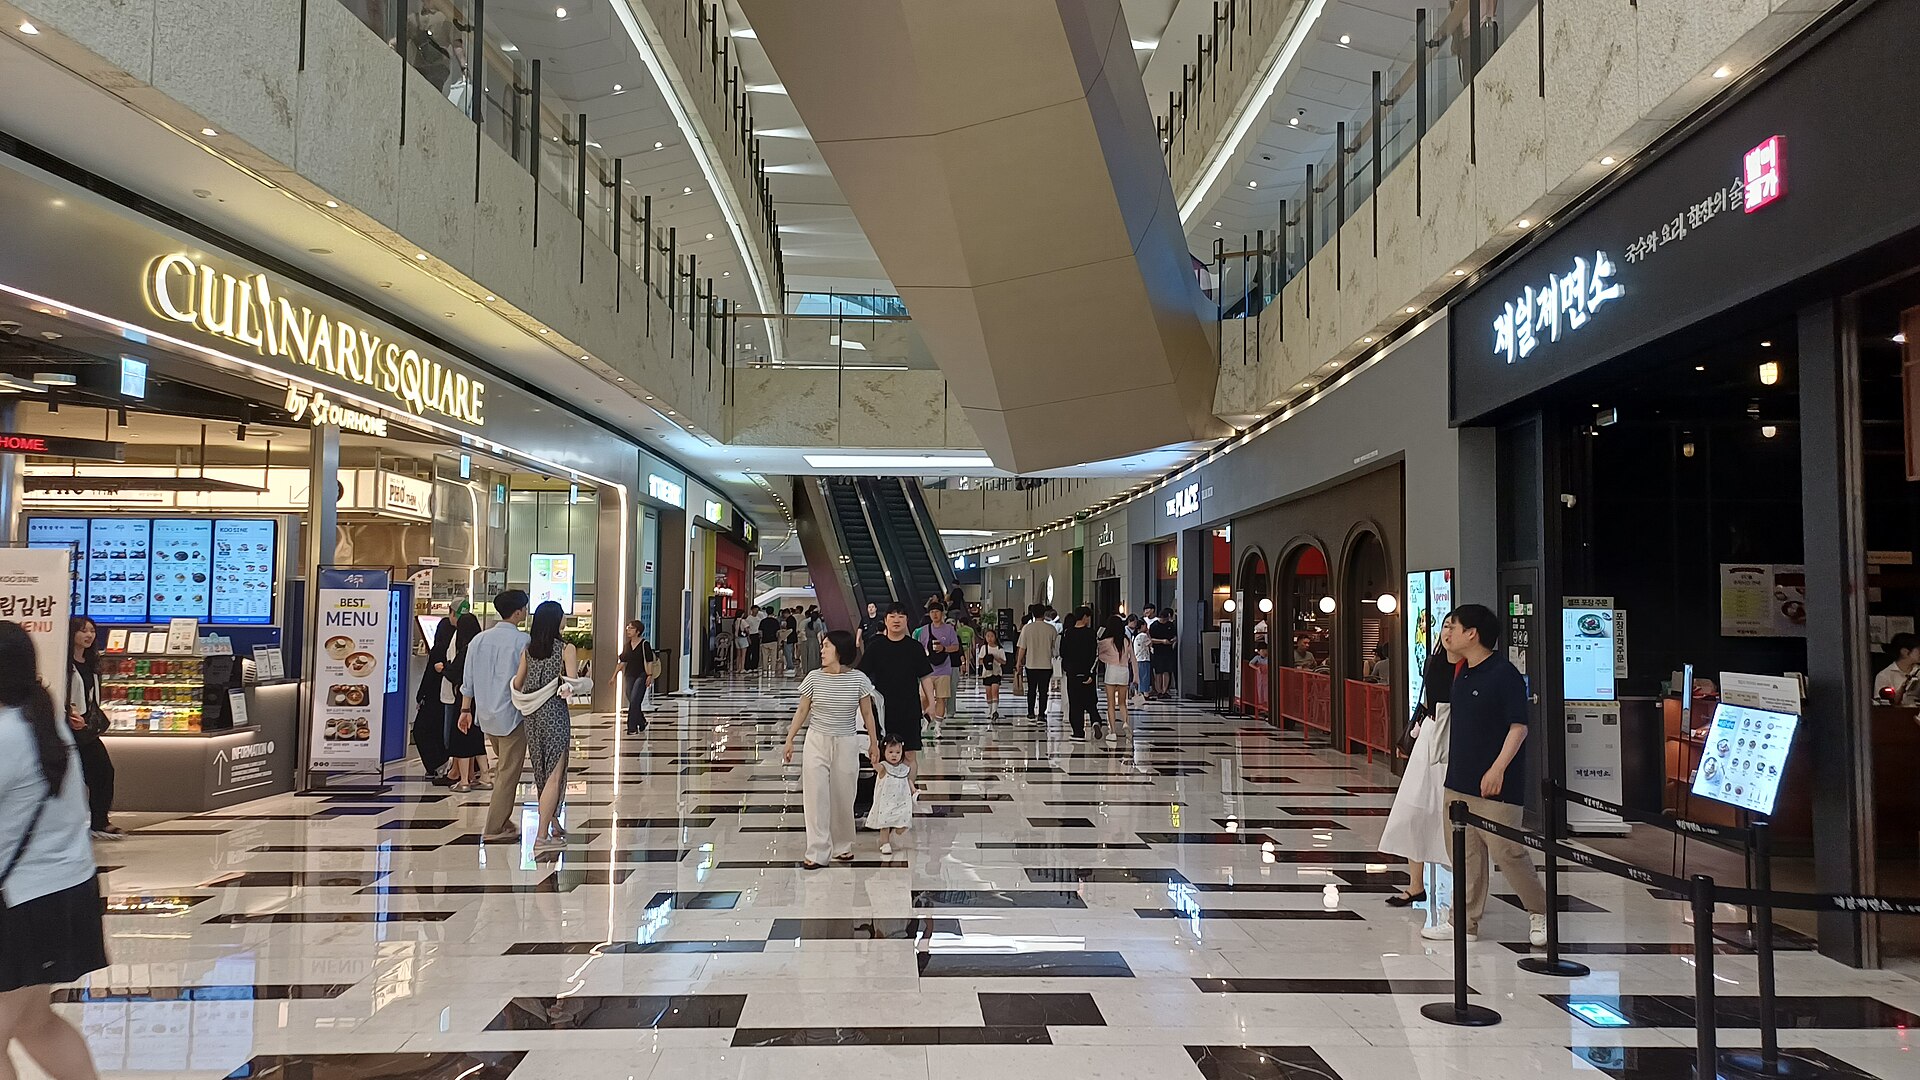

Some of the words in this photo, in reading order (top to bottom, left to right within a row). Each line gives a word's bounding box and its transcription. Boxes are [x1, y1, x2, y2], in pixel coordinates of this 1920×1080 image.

[1624, 231, 1659, 264] 국수와
[1687, 188, 1726, 229] 한잔의
[1493, 250, 1624, 364] 제일제면소
[147, 253, 381, 385] CULINARY
[385, 343, 486, 427] SQUARE
[285, 386, 309, 422] by
[326, 611, 380, 627] MENU
[340, 598, 366, 608] BEST
[231, 742, 268, 761] INFORMATION
